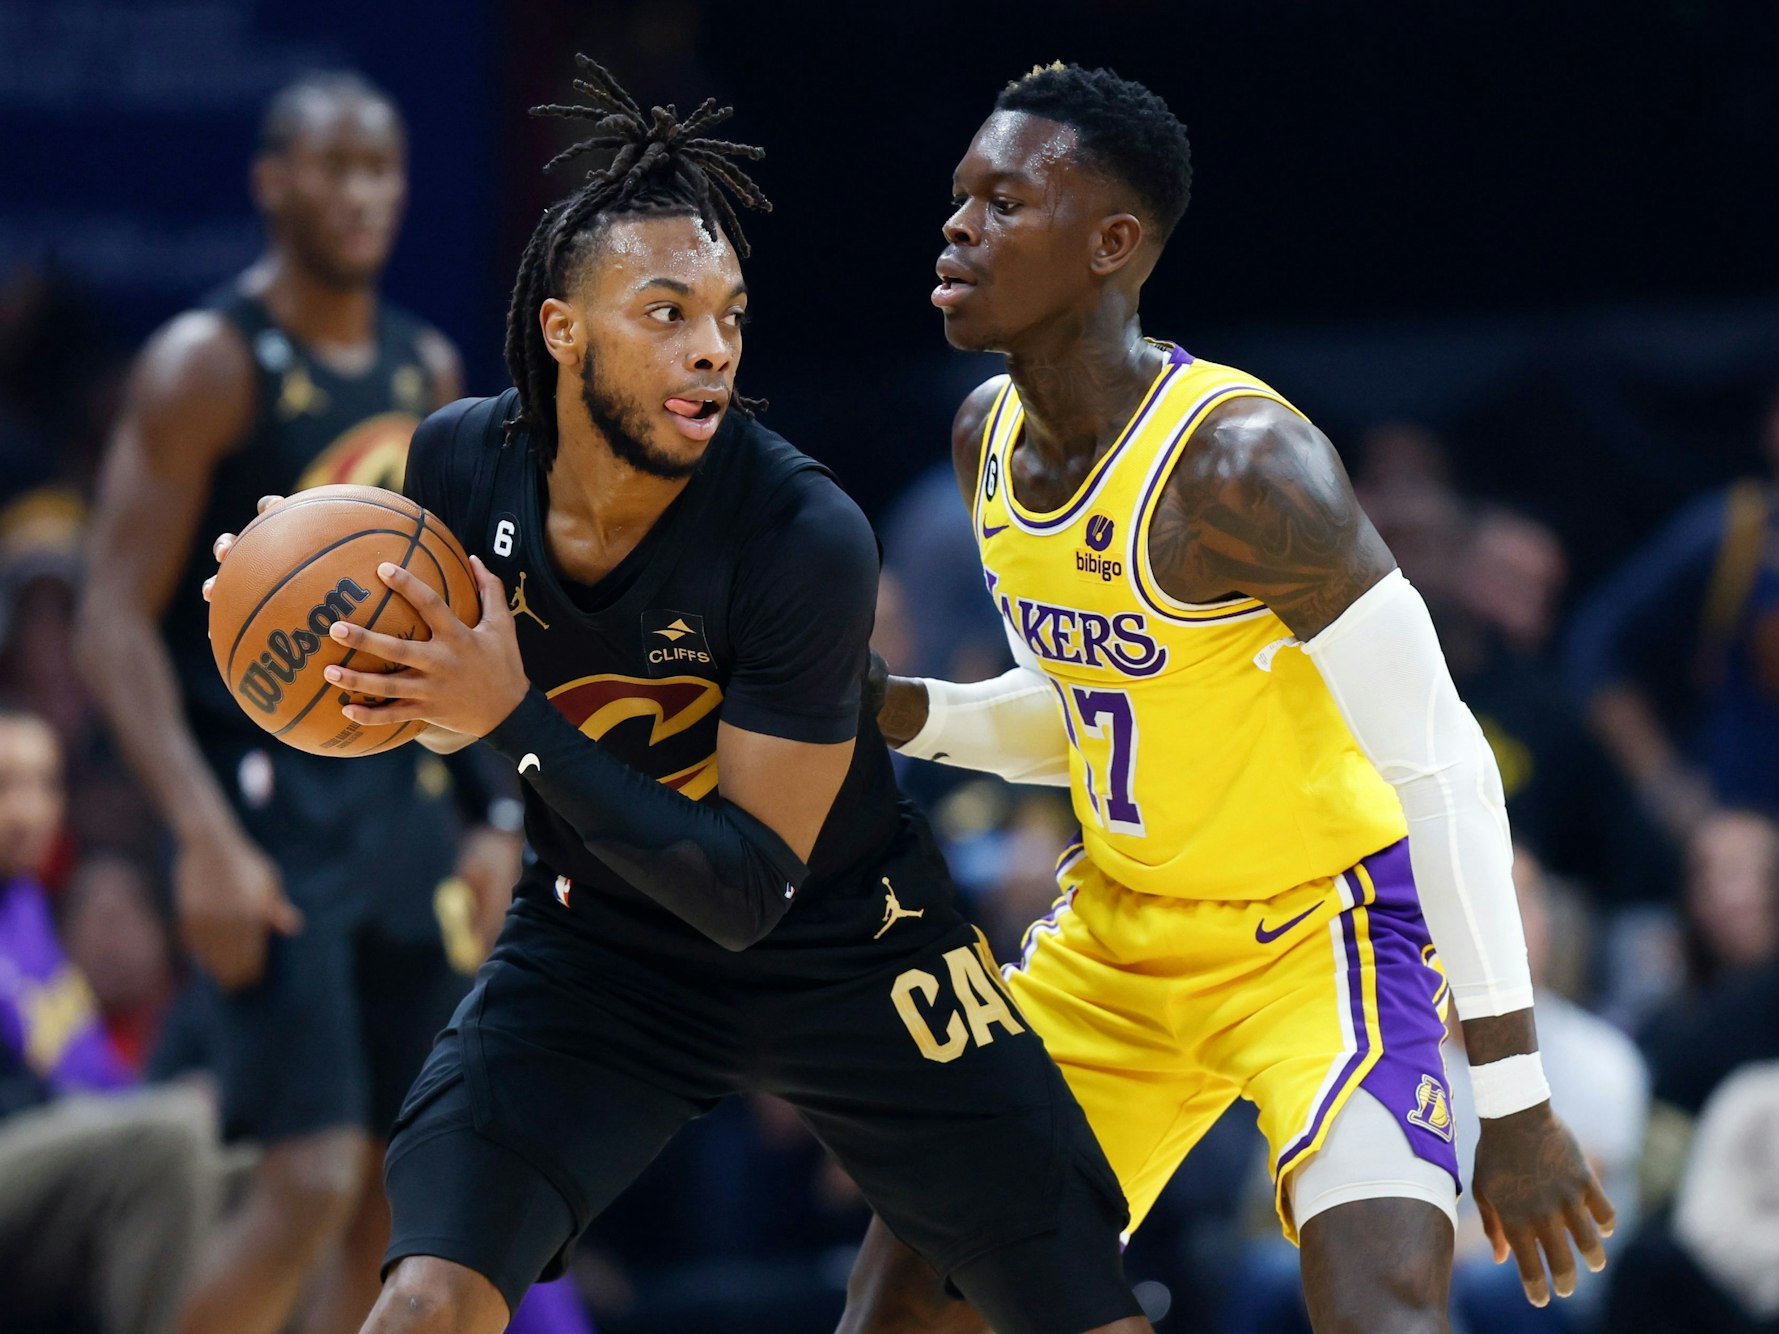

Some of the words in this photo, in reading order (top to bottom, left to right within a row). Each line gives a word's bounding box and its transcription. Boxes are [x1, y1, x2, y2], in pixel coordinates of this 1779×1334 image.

[987, 459, 997, 497] 6
[493, 519, 515, 558] 6
[1076, 551, 1122, 582] bibigo
[238, 576, 371, 715] Wilson
[648, 647, 711, 664] CLIFFS
[1049, 676, 1147, 838] 7
[890, 924, 1040, 1063] CA
